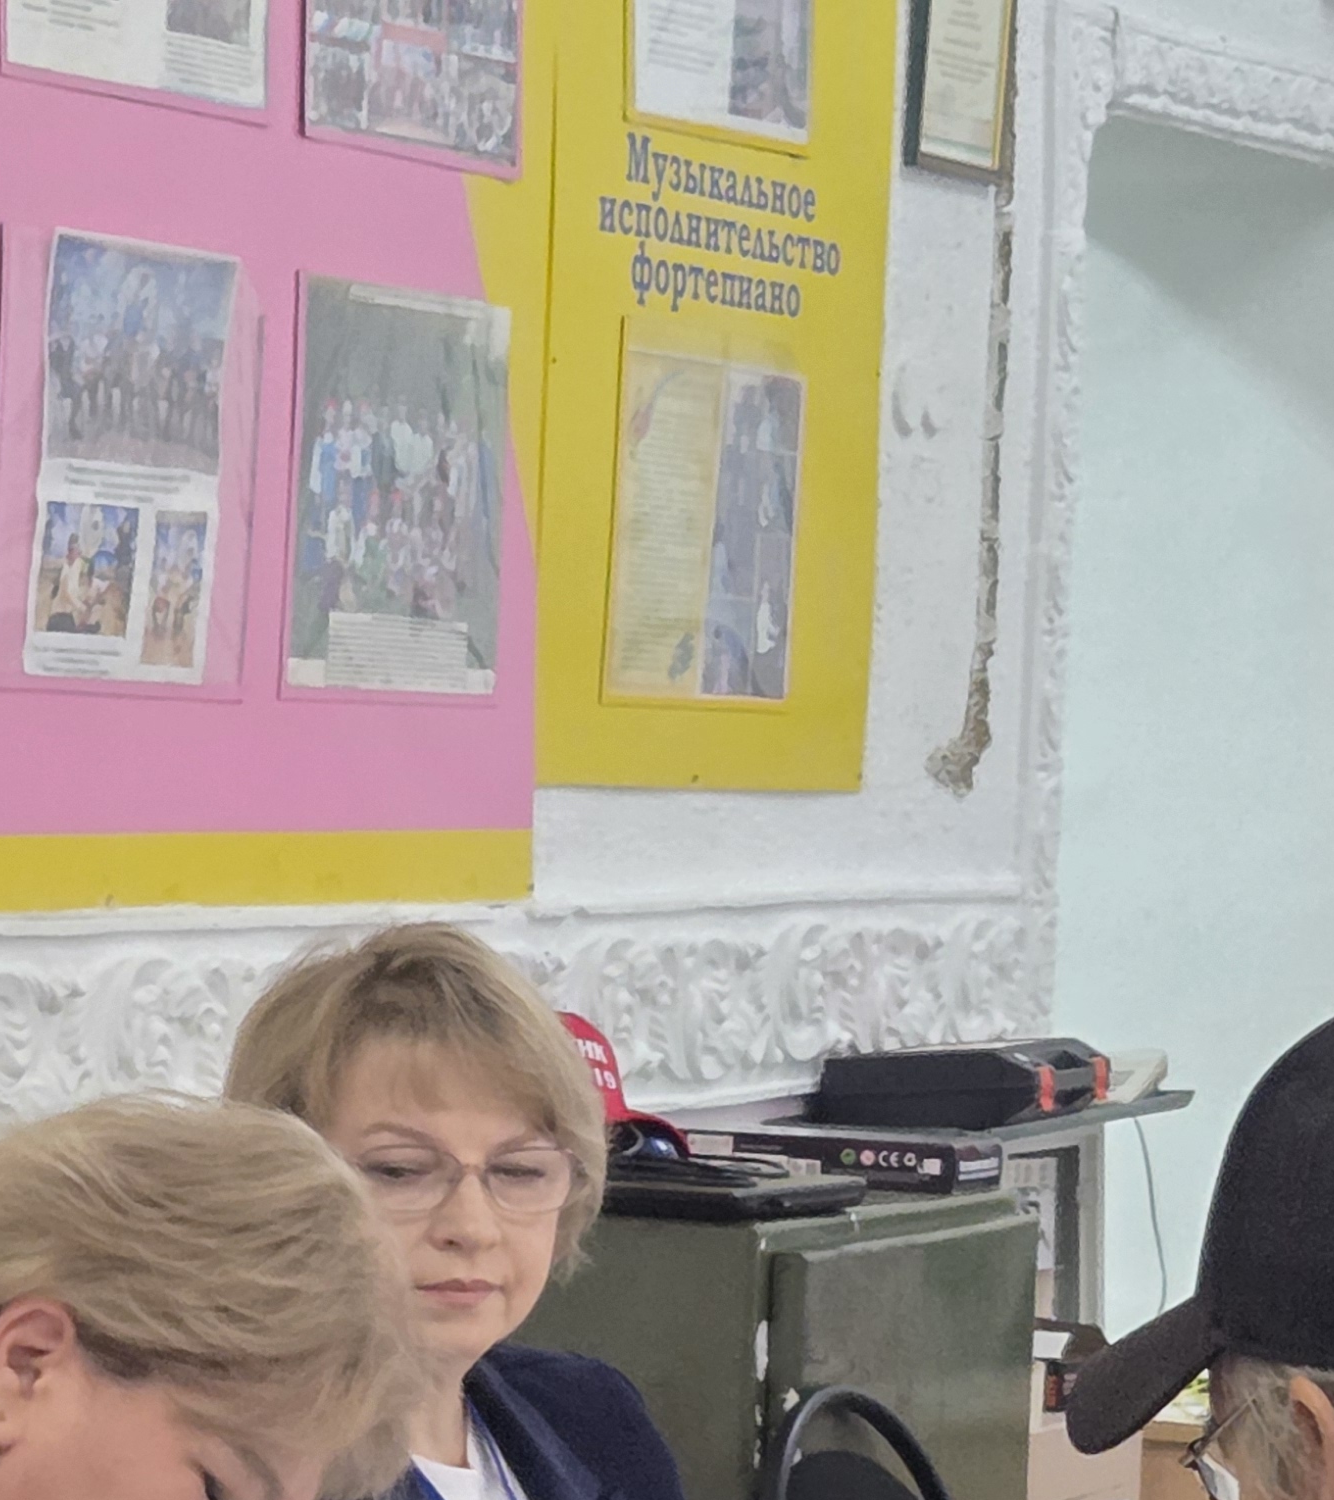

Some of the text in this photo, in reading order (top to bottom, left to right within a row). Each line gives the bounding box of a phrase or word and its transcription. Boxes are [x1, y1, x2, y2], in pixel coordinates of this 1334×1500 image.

[625, 131, 817, 223] Музыкальное
[598, 195, 841, 277] исполнительство
[630, 240, 802, 318] фортепиано
[593, 1067, 618, 1090] 19
